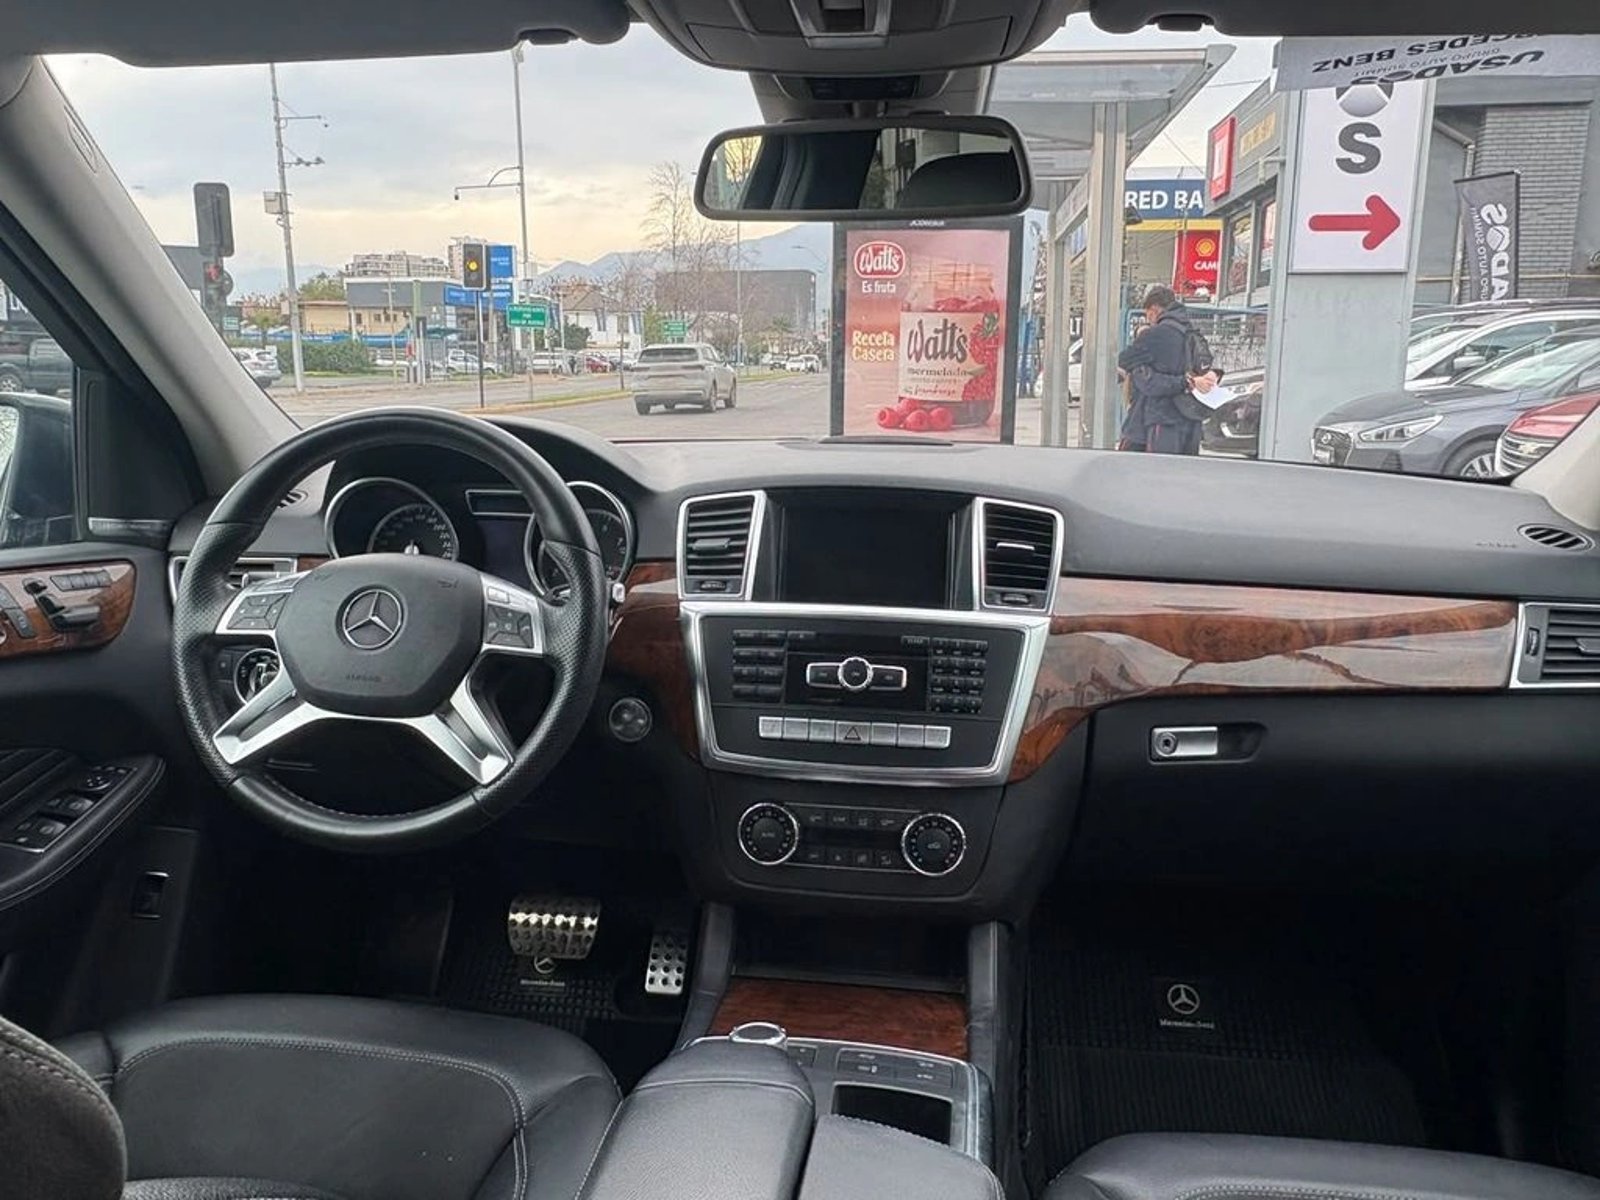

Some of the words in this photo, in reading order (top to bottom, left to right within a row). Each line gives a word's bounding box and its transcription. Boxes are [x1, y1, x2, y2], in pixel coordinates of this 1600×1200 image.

[1312, 48, 1396, 73] BENZ
[1350, 50, 1544, 85] USADOS
[862, 280, 873, 293] Es
[874, 280, 896, 293] fruta
[852, 330, 895, 347] Receta
[852, 346, 895, 361] Casera
